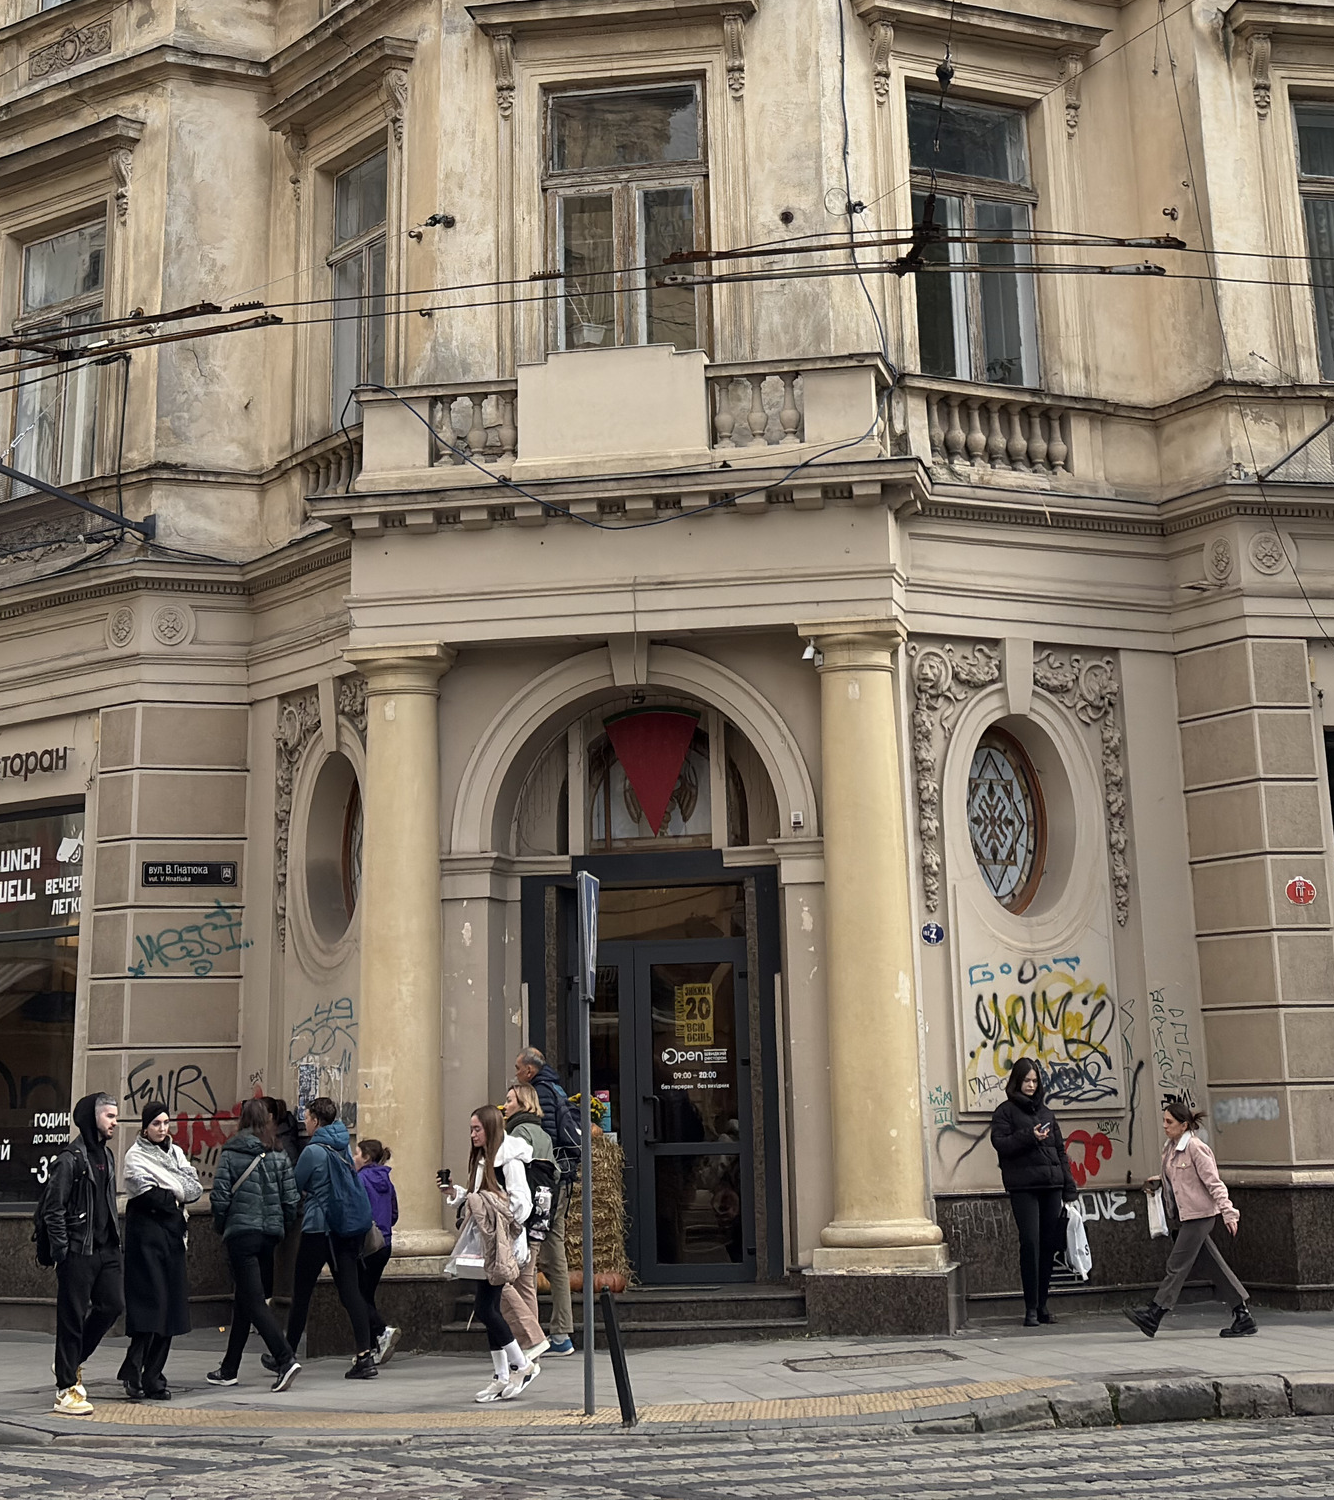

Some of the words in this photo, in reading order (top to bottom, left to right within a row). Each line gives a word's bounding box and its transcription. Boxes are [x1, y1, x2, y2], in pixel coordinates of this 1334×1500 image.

[148, 866, 164, 875] вул.
[1295, 886, 1306, 897] ПГ
[687, 1023, 705, 1032] ВСЮ
[662, 1047, 703, 1065] Open
[32, 1134, 44, 1145] до
[30, 1154, 58, 1184] -3
